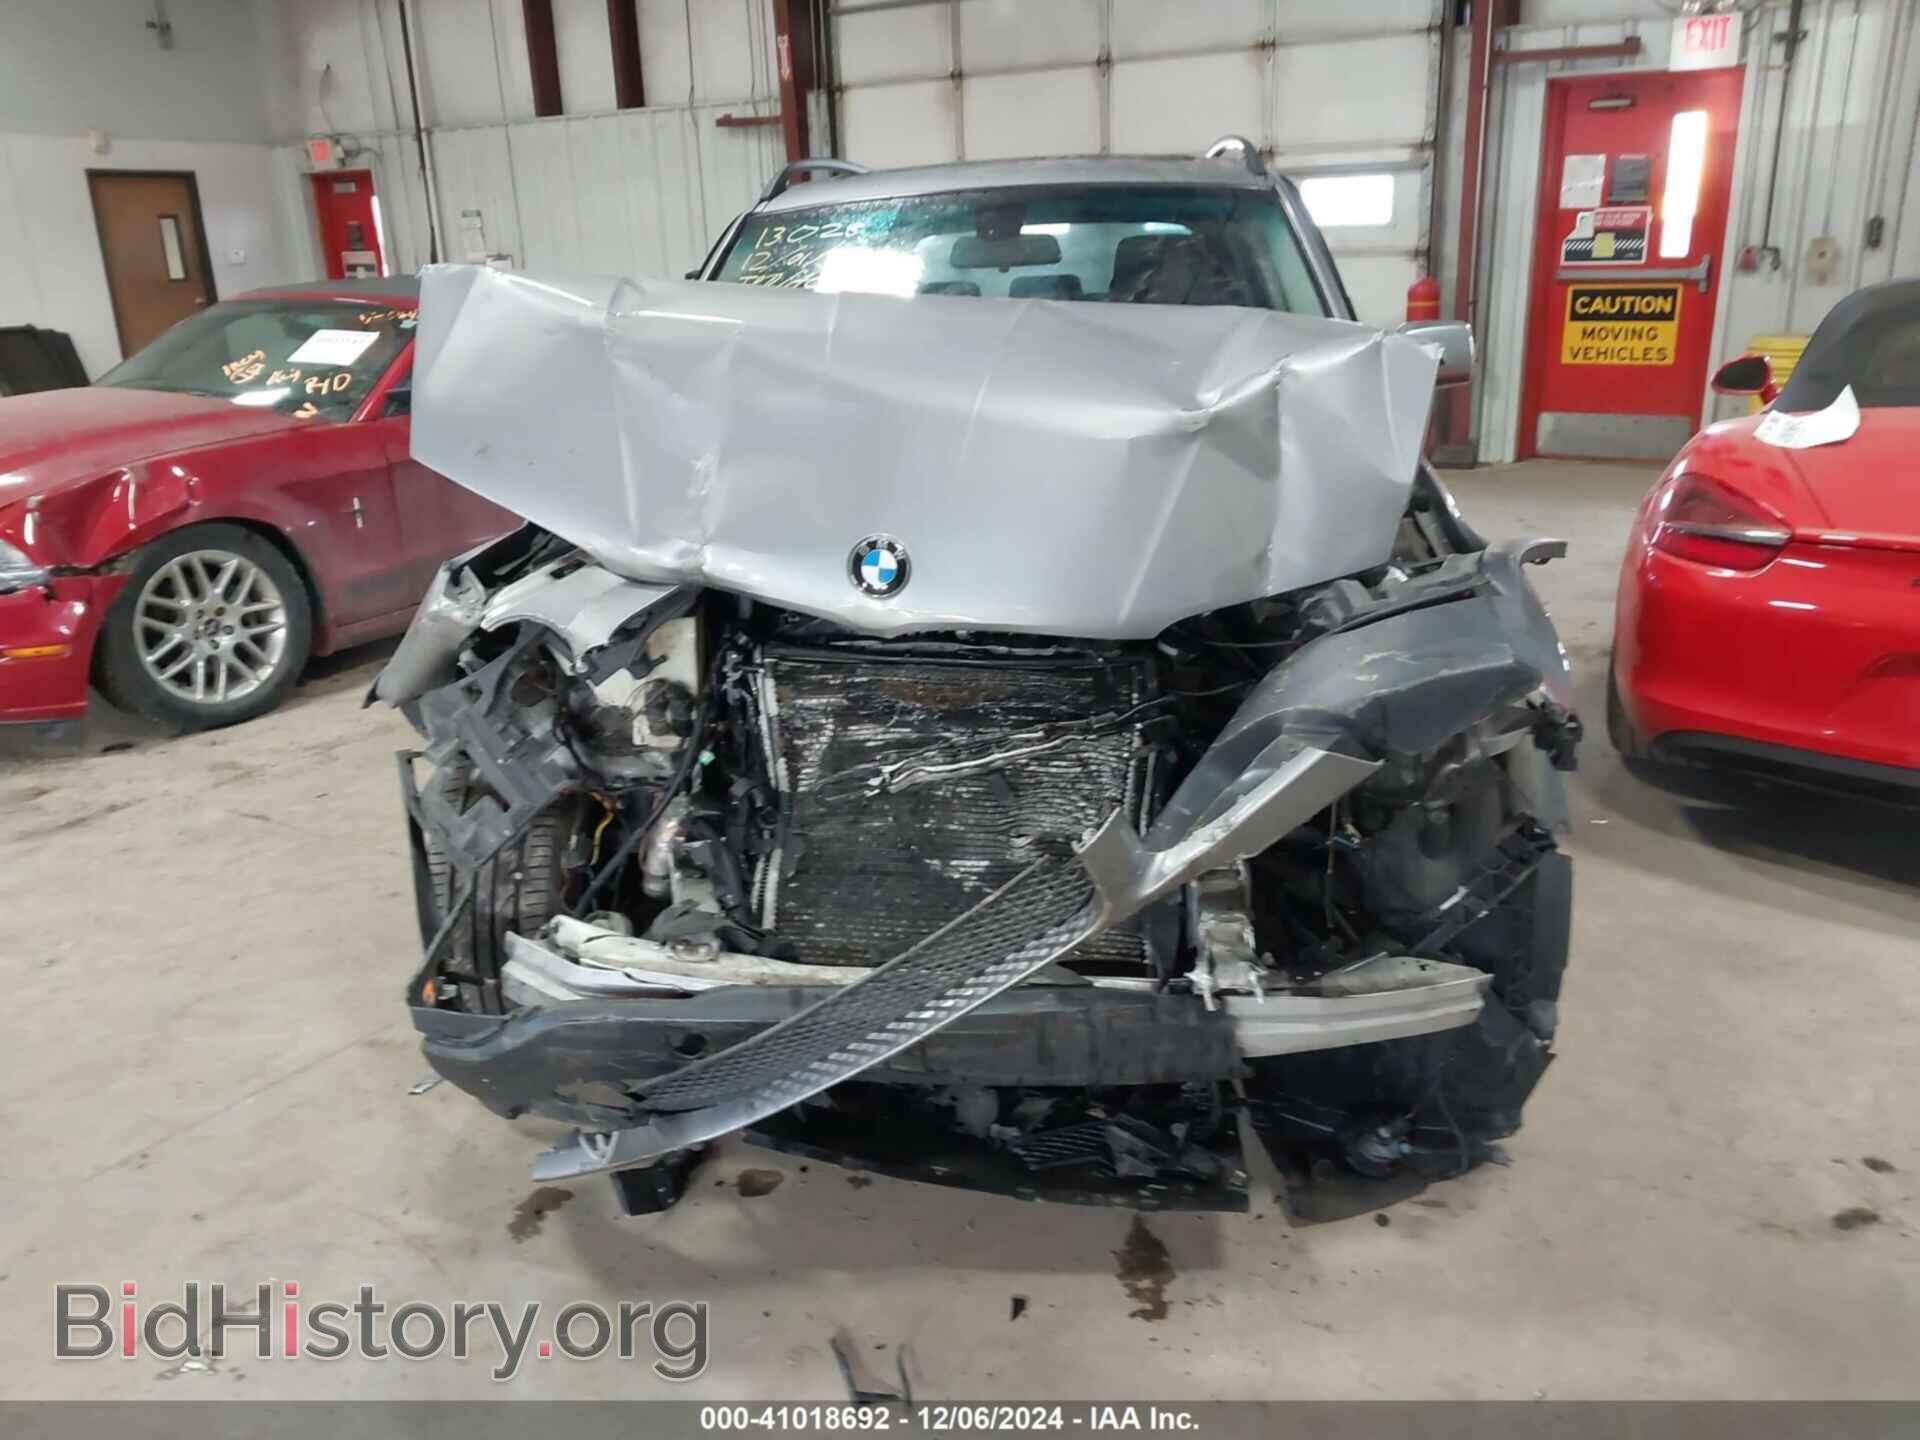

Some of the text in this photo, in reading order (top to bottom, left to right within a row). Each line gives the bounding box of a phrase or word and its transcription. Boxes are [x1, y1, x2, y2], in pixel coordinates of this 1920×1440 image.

[1685, 16, 1731, 50] EXIT
[1574, 295, 1673, 315] CAUTION
[1581, 324, 1659, 341] MOVING
[1570, 346, 1669, 362] VEHICLES
